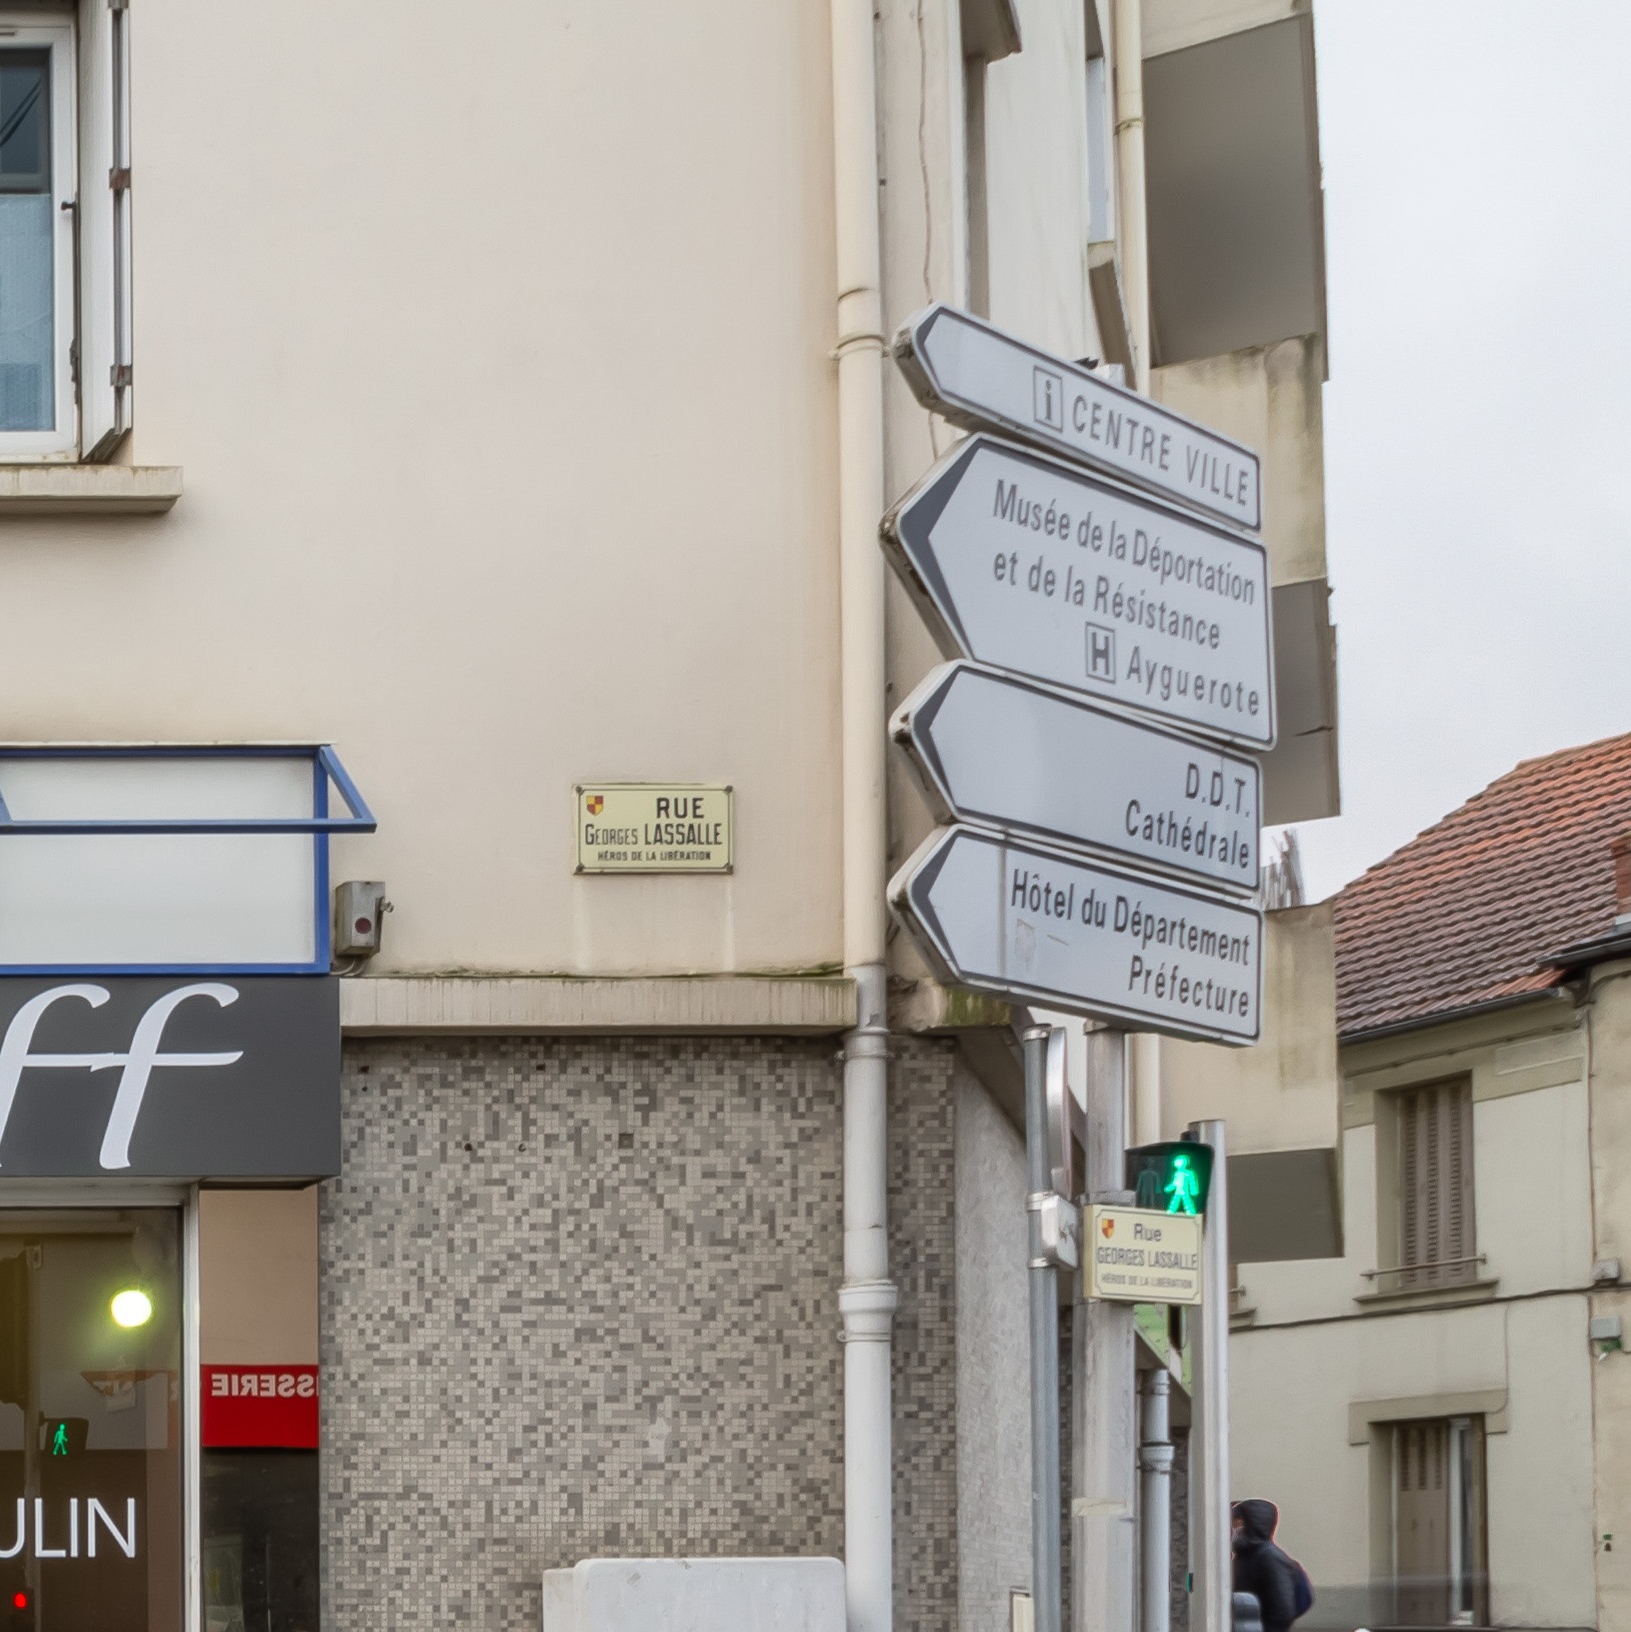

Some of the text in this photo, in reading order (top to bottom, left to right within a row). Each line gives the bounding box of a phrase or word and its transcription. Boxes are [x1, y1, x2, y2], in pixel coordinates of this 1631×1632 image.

[1072, 394, 1172, 471] CENTRE
[1186, 445, 1249, 506] VILLE
[993, 479, 1255, 605] Musée de la Déportation
[993, 552, 1220, 650] et de la Résistance
[1126, 645, 1259, 716] Ayguerote
[656, 797, 705, 819] RUE
[1185, 762, 1250, 818] D.D.T.
[631, 852, 643, 861] DE
[645, 852, 656, 861] LA
[660, 850, 712, 861] LIBÉRATION
[644, 823, 723, 846] LASSALLE
[1125, 799, 1249, 869] Cathédrale
[1010, 868, 1250, 966] Hôtel du Département
[1127, 954, 1249, 1018] Préfecture
[1097, 1247, 1198, 1271] GEORGES LASSALLE
[1133, 1223, 1162, 1242] Rue
